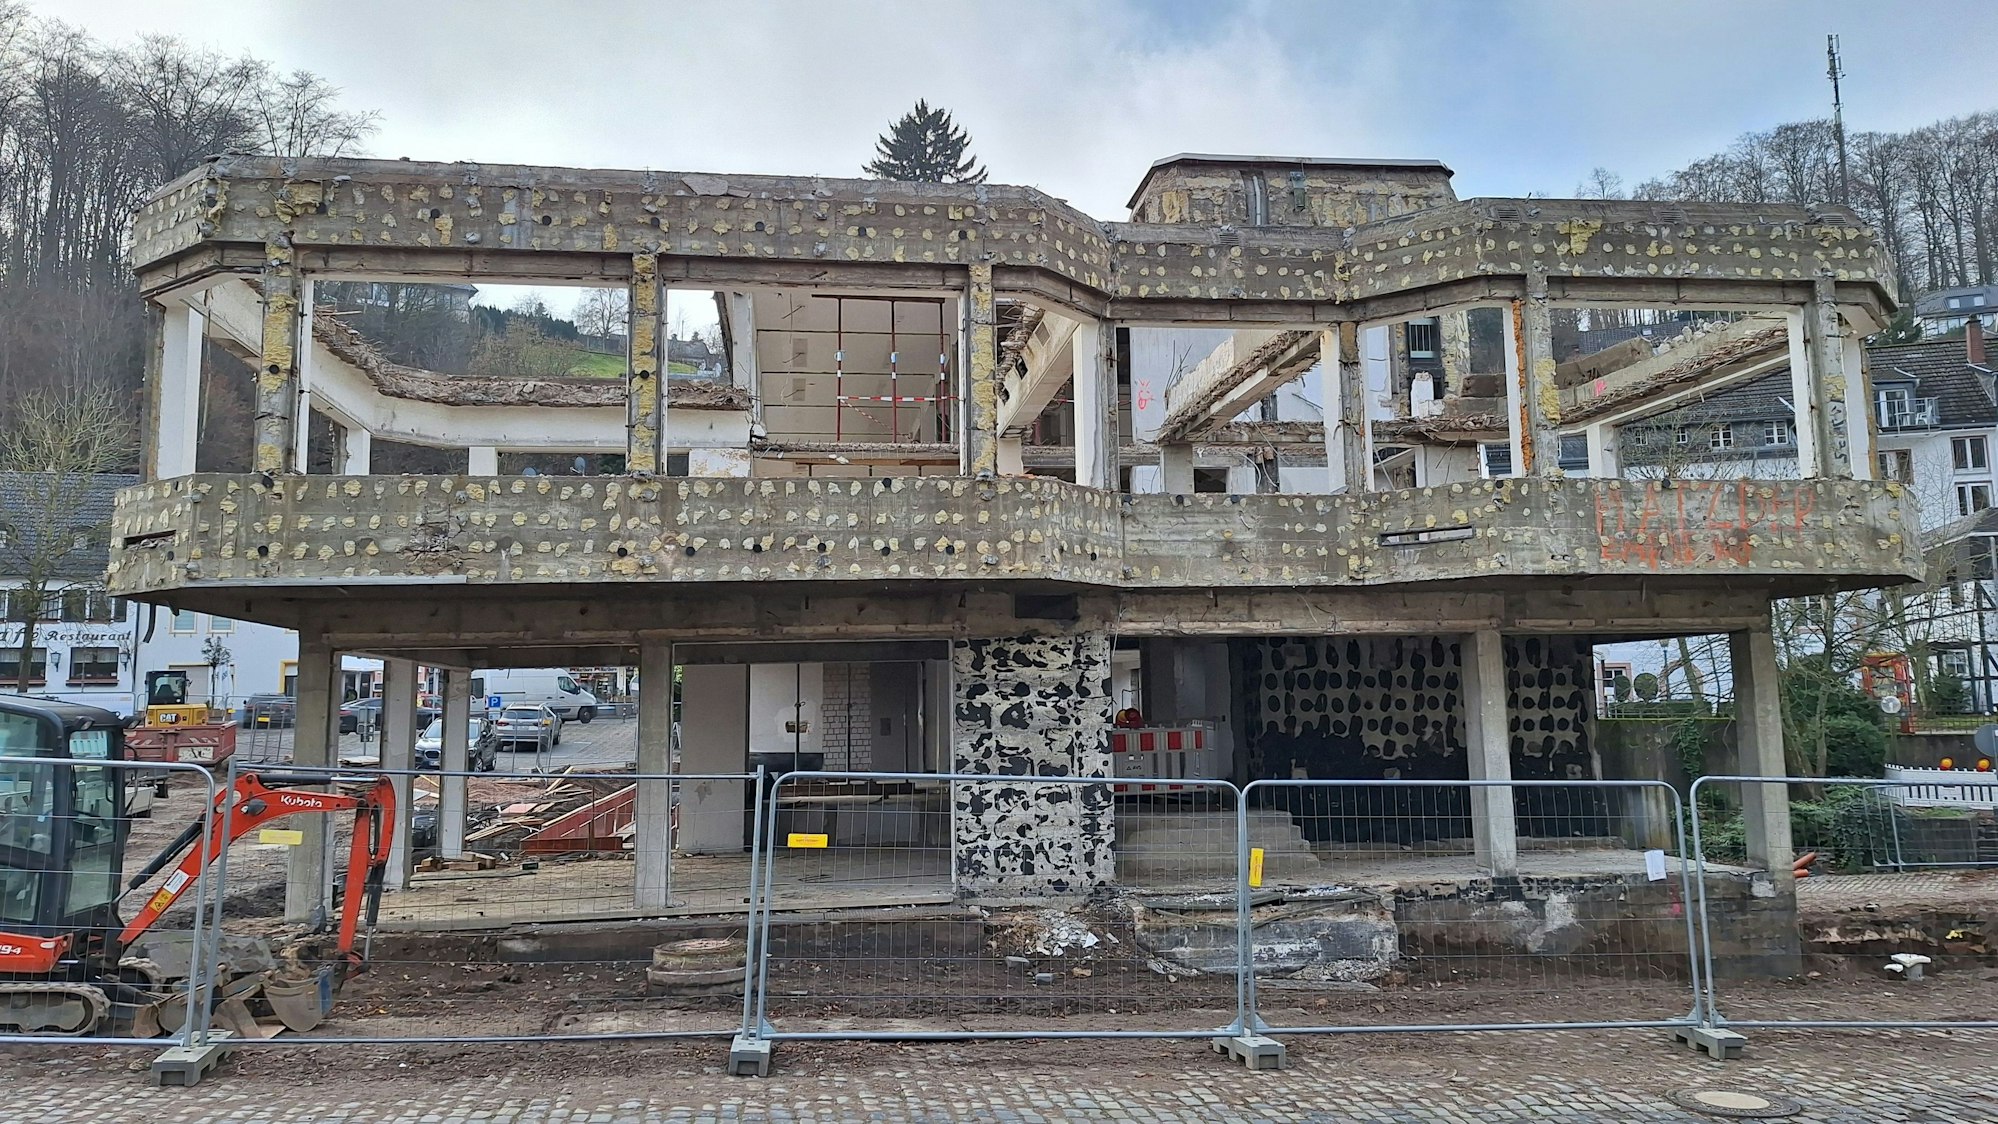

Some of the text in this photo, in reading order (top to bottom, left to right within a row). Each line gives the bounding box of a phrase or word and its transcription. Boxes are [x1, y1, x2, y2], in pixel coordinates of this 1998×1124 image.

[45, 630, 132, 643] Restaurant
[491, 697, 499, 706] P
[160, 713, 178, 723] CAT
[280, 794, 323, 808] Kubota
